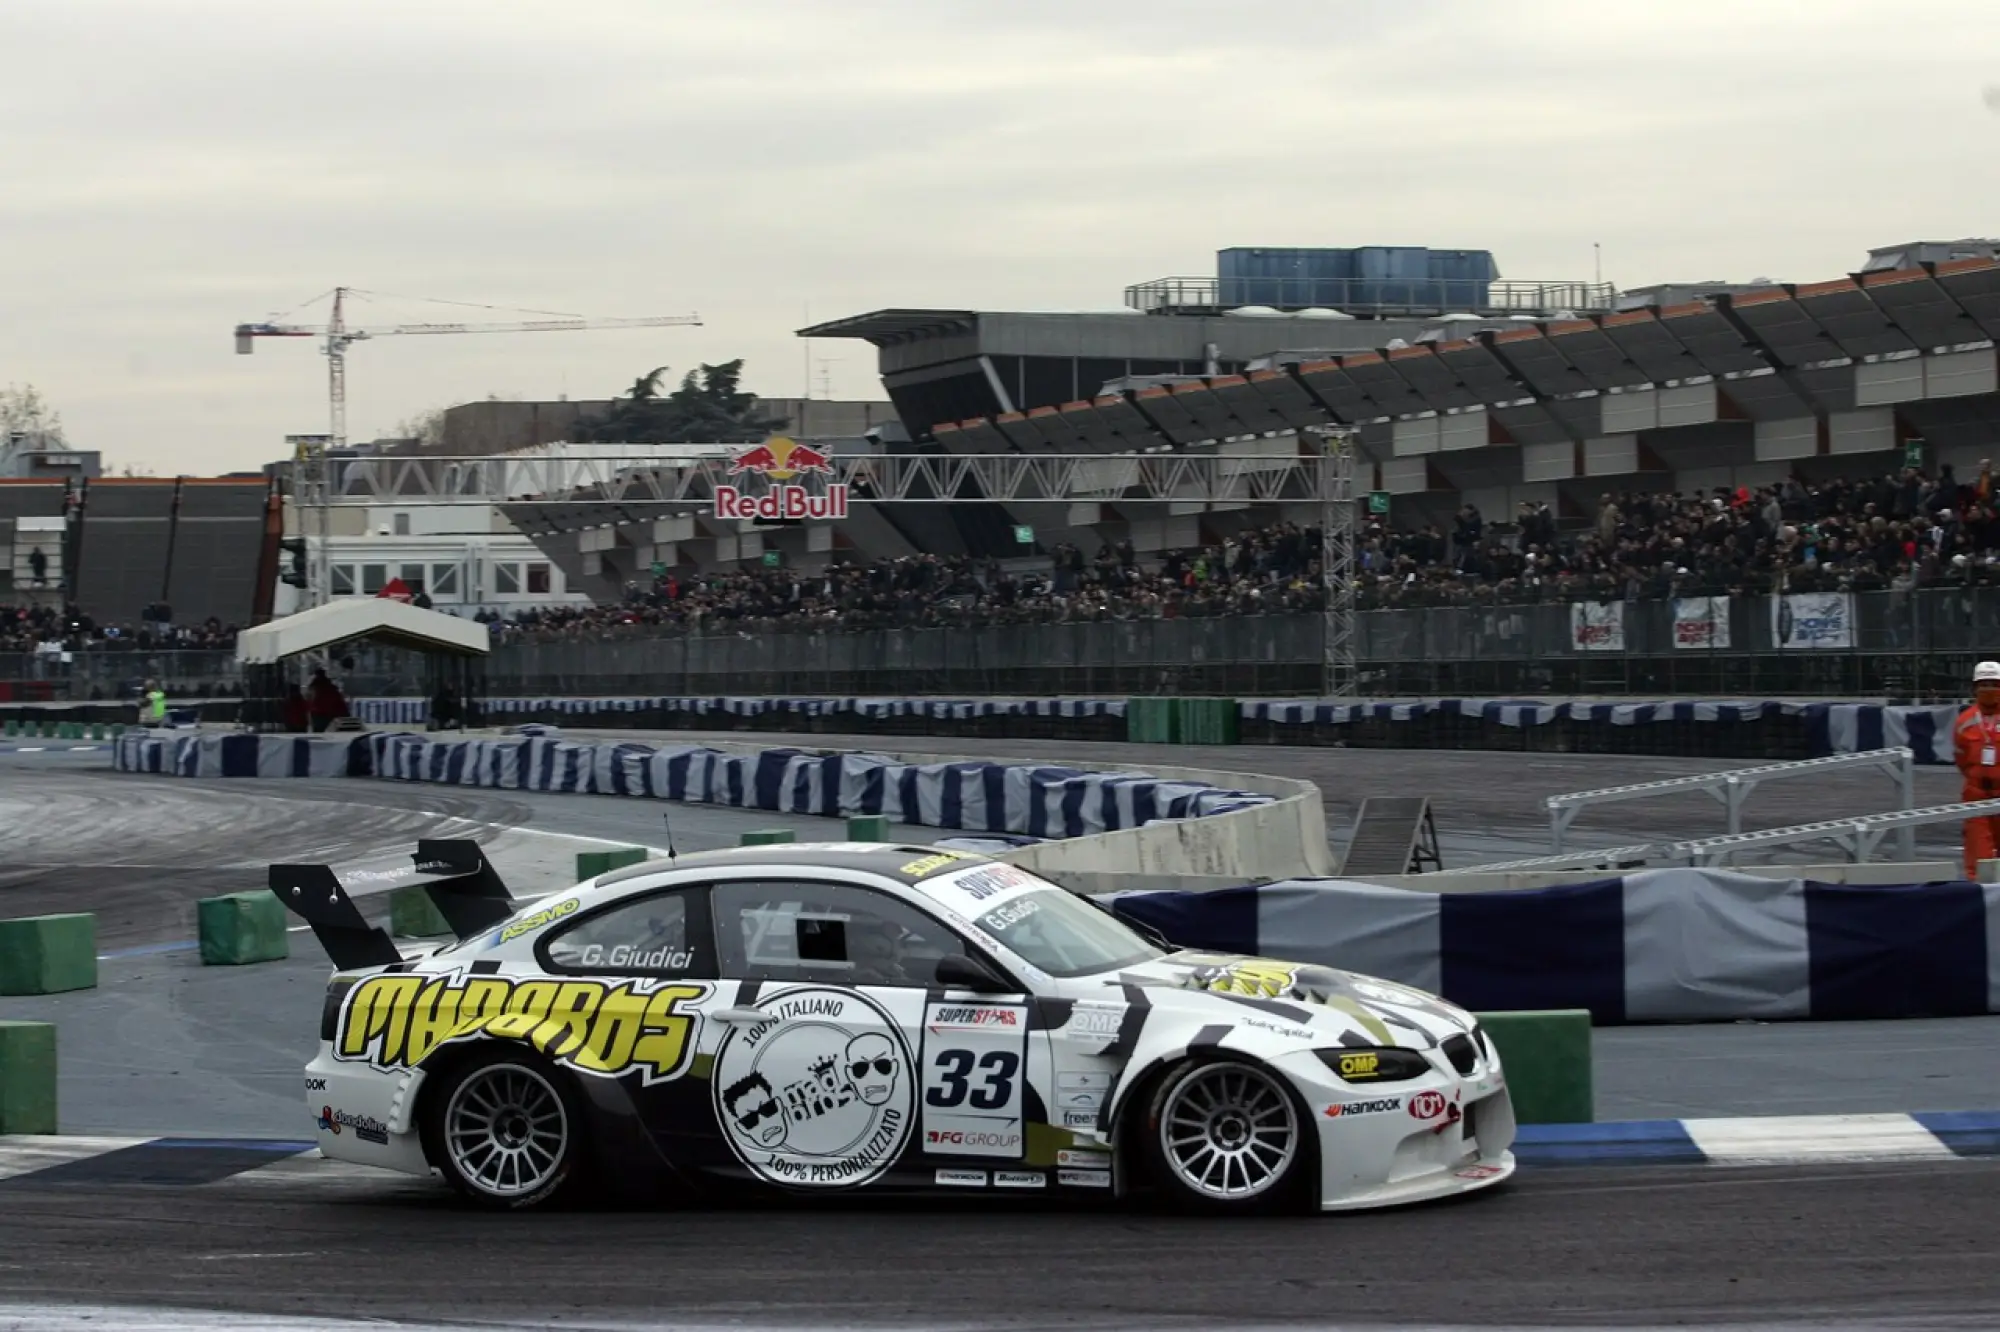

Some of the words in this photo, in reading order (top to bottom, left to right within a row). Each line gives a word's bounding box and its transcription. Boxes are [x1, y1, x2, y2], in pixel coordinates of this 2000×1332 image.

[715, 484, 781, 518] Red
[784, 484, 848, 518] Bull
[780, 998, 844, 1021] ITALIANO
[936, 1007, 1017, 1026] SUPERSTARS
[925, 1049, 1020, 1109] 33
[1341, 1056, 1378, 1074] OMP
[766, 1153, 807, 1181] 100%
[810, 1108, 902, 1182] PERSONALIZZATO
